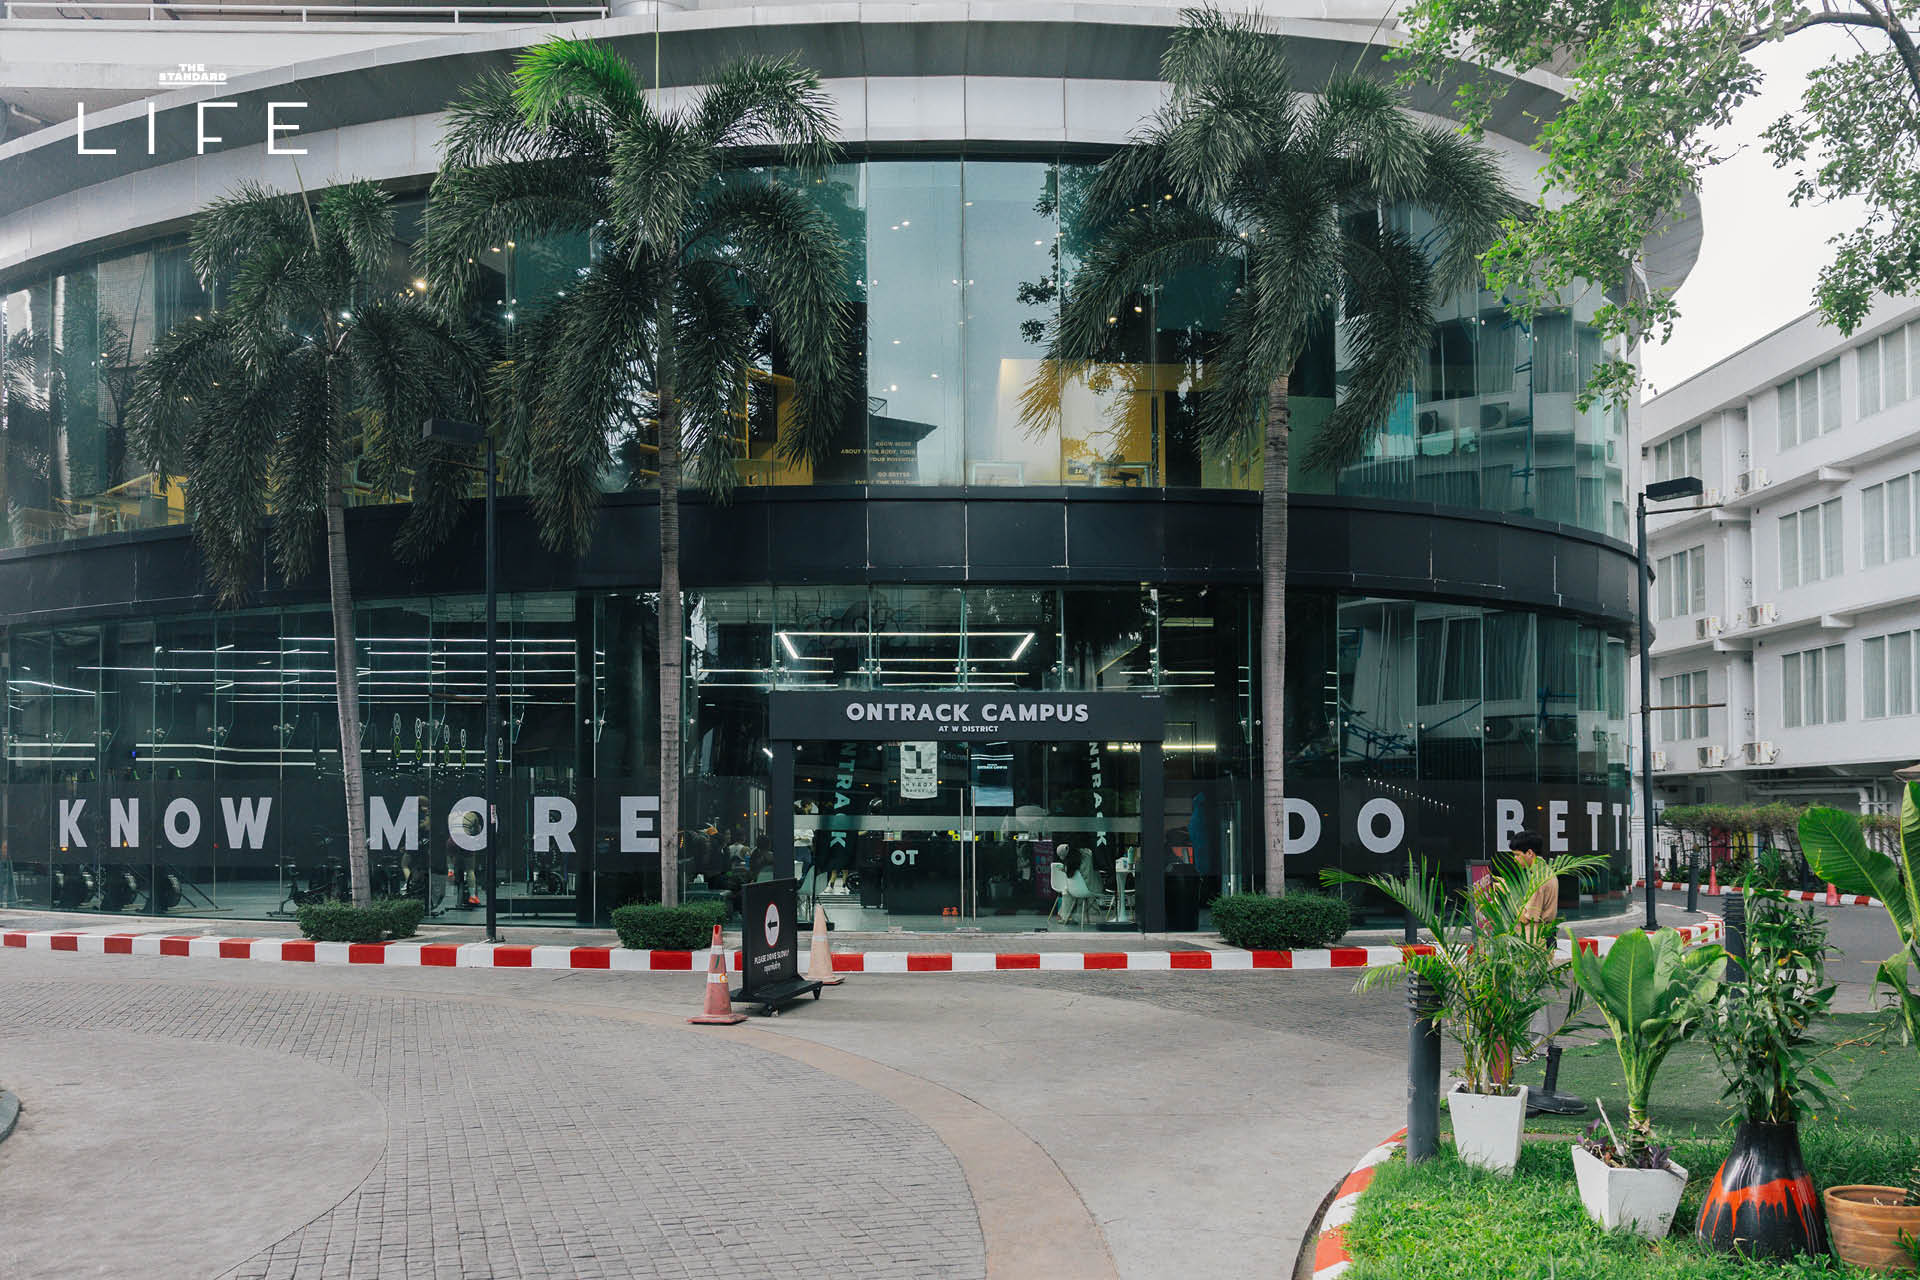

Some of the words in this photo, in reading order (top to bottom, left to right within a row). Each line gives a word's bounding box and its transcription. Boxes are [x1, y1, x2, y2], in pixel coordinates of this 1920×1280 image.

[846, 702, 970, 722] ONTRACK
[981, 702, 1089, 722] CAMPUS
[59, 796, 273, 850] KNOW
[368, 796, 660, 853] MORE
[1283, 797, 1405, 855] DO
[1496, 798, 1631, 852] BETT
[891, 849, 918, 866] OT
